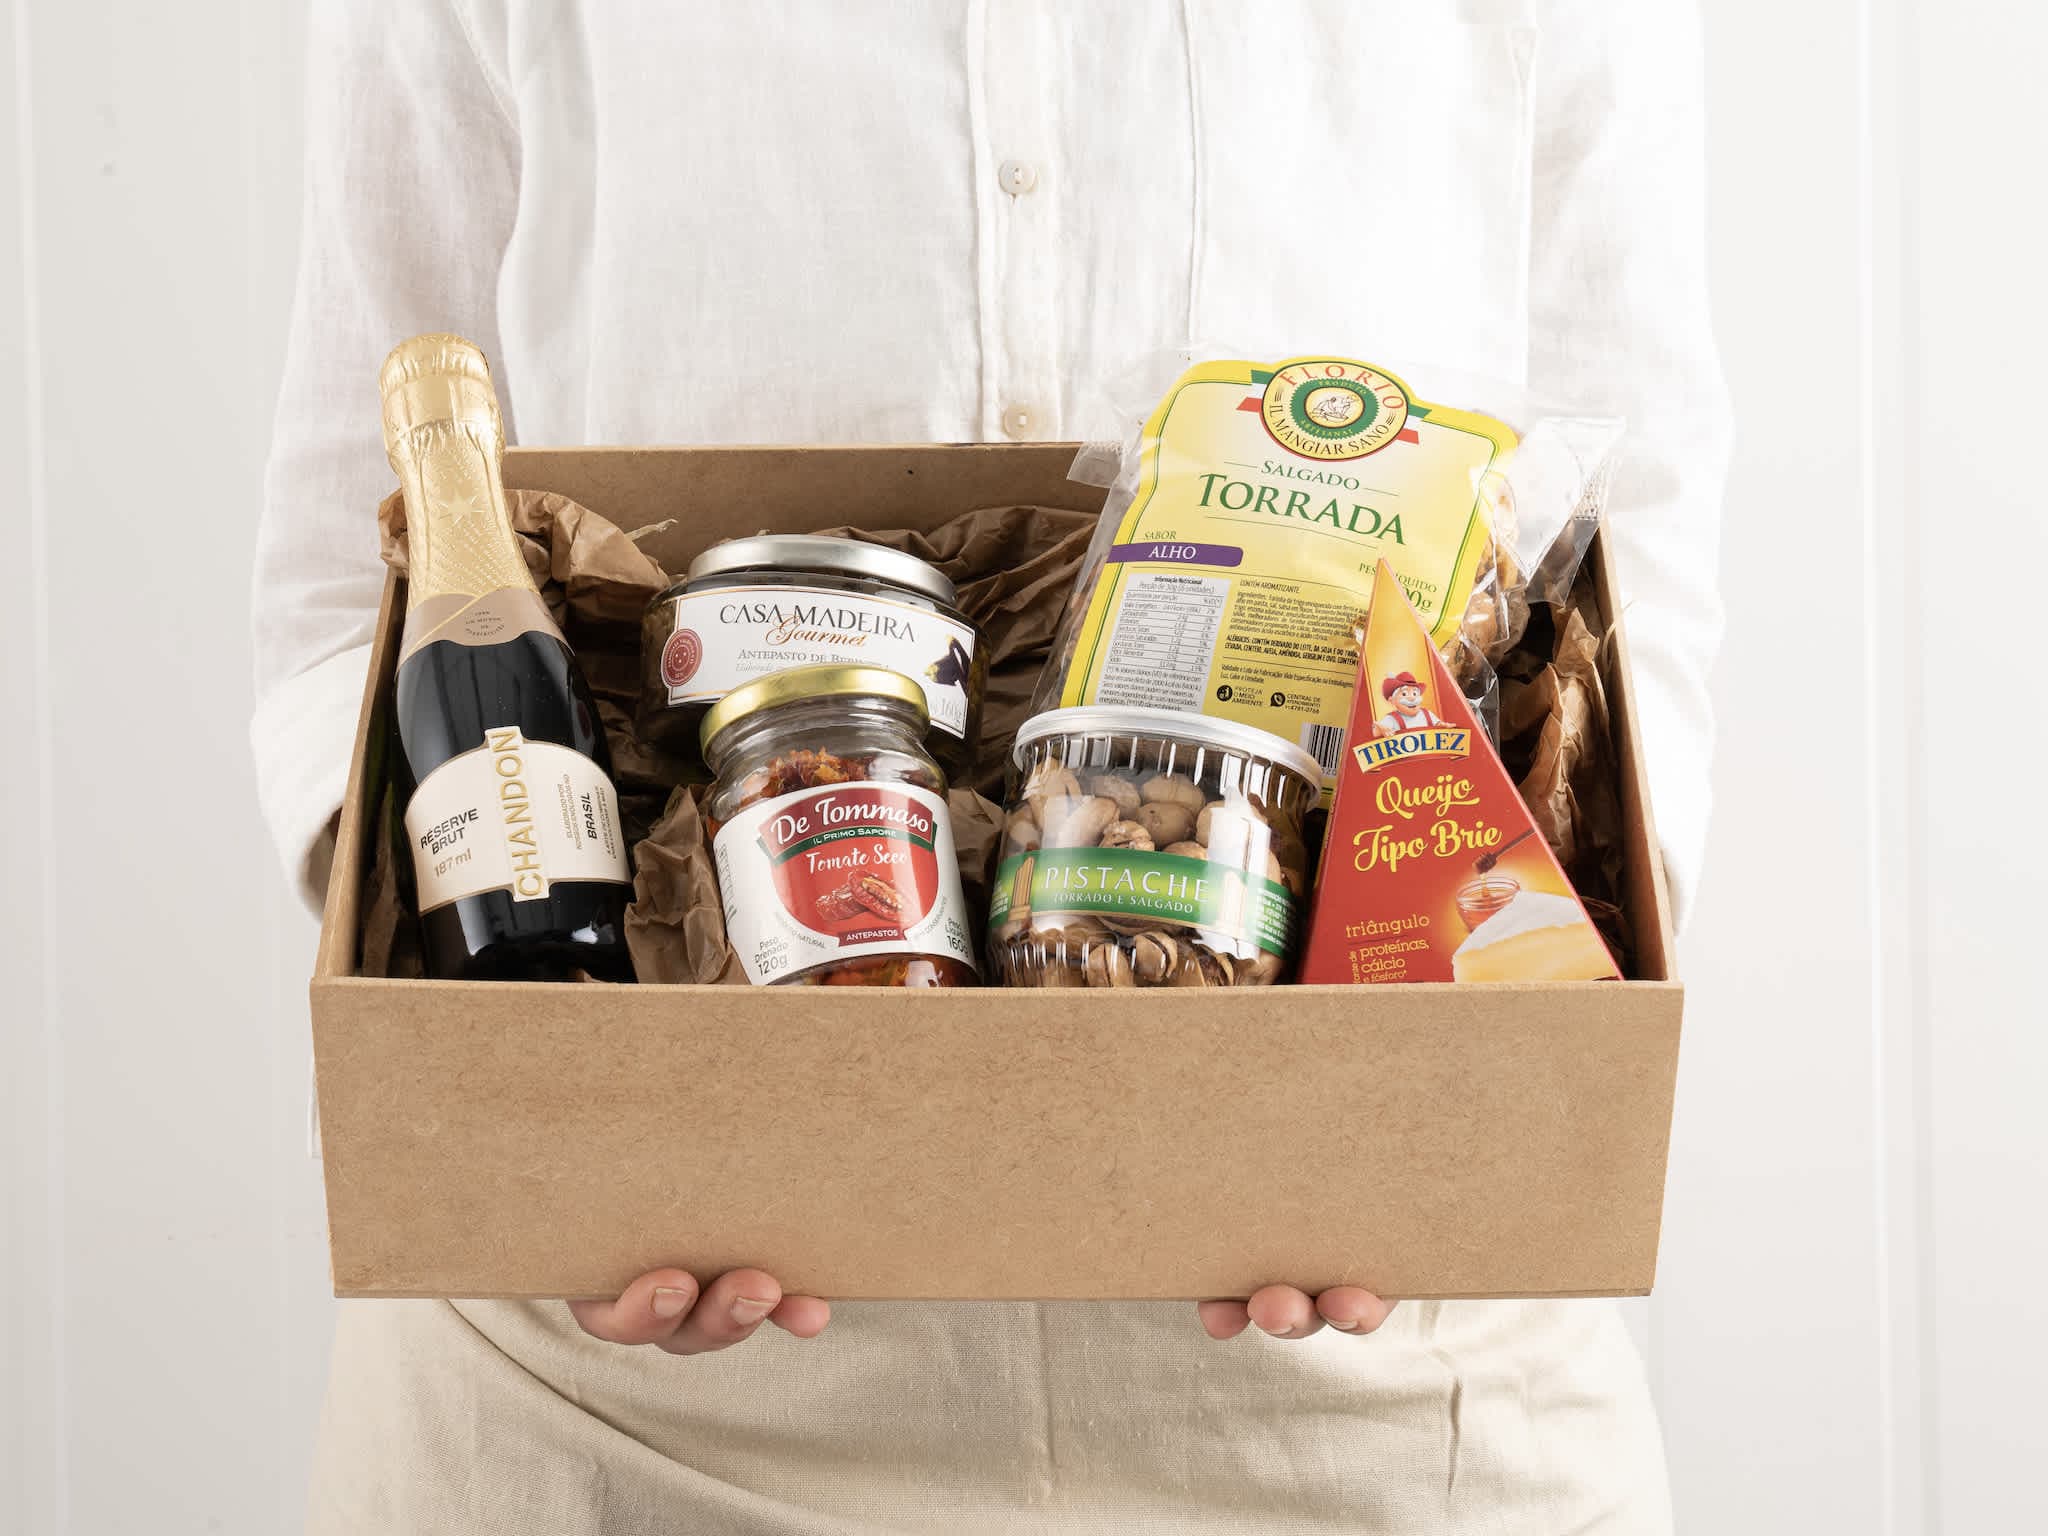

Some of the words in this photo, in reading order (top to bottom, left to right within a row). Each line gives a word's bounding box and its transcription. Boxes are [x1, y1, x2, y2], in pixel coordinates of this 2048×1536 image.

[1278, 364, 1404, 409] FLORIO
[1272, 419, 1345, 455] MANGIAR
[1349, 423, 1390, 453] SANO
[1261, 460, 1360, 491] SALGADO
[1198, 472, 1407, 546] TORRADA
[1144, 530, 1177, 540] SABOR
[1148, 544, 1197, 560] ALHO
[719, 603, 784, 625] CASA
[793, 606, 915, 643] MADEIRA
[765, 614, 867, 647] Gourmet
[737, 649, 807, 662] ANTEPASTO
[1358, 731, 1467, 766] TIROLEZ
[1375, 774, 1481, 819] Queijo
[491, 730, 546, 897] CHANDON
[580, 792, 598, 840] BRASIL
[770, 815, 810, 845] De
[815, 796, 929, 833] Tommaso
[431, 827, 465, 855] BRUT
[813, 836, 822, 845] IL
[823, 829, 856, 842] PRIMO
[857, 828, 897, 838] SAPORE
[1352, 823, 1429, 873] Tipo
[1430, 819, 1503, 858] Brie
[805, 850, 870, 874] Tomate
[874, 844, 909, 865] Seco
[1044, 866, 1209, 903] PISTACHE
[1117, 895, 1125, 905] E
[1128, 894, 1194, 914] SALGADO
[846, 929, 899, 941] ANTEPASTOS
[1345, 913, 1430, 938] triângulo
[759, 936, 778, 951] Peso
[1359, 939, 1430, 961] proteínas,
[758, 955, 787, 976] 120g
[1360, 956, 1406, 973] cálcio
